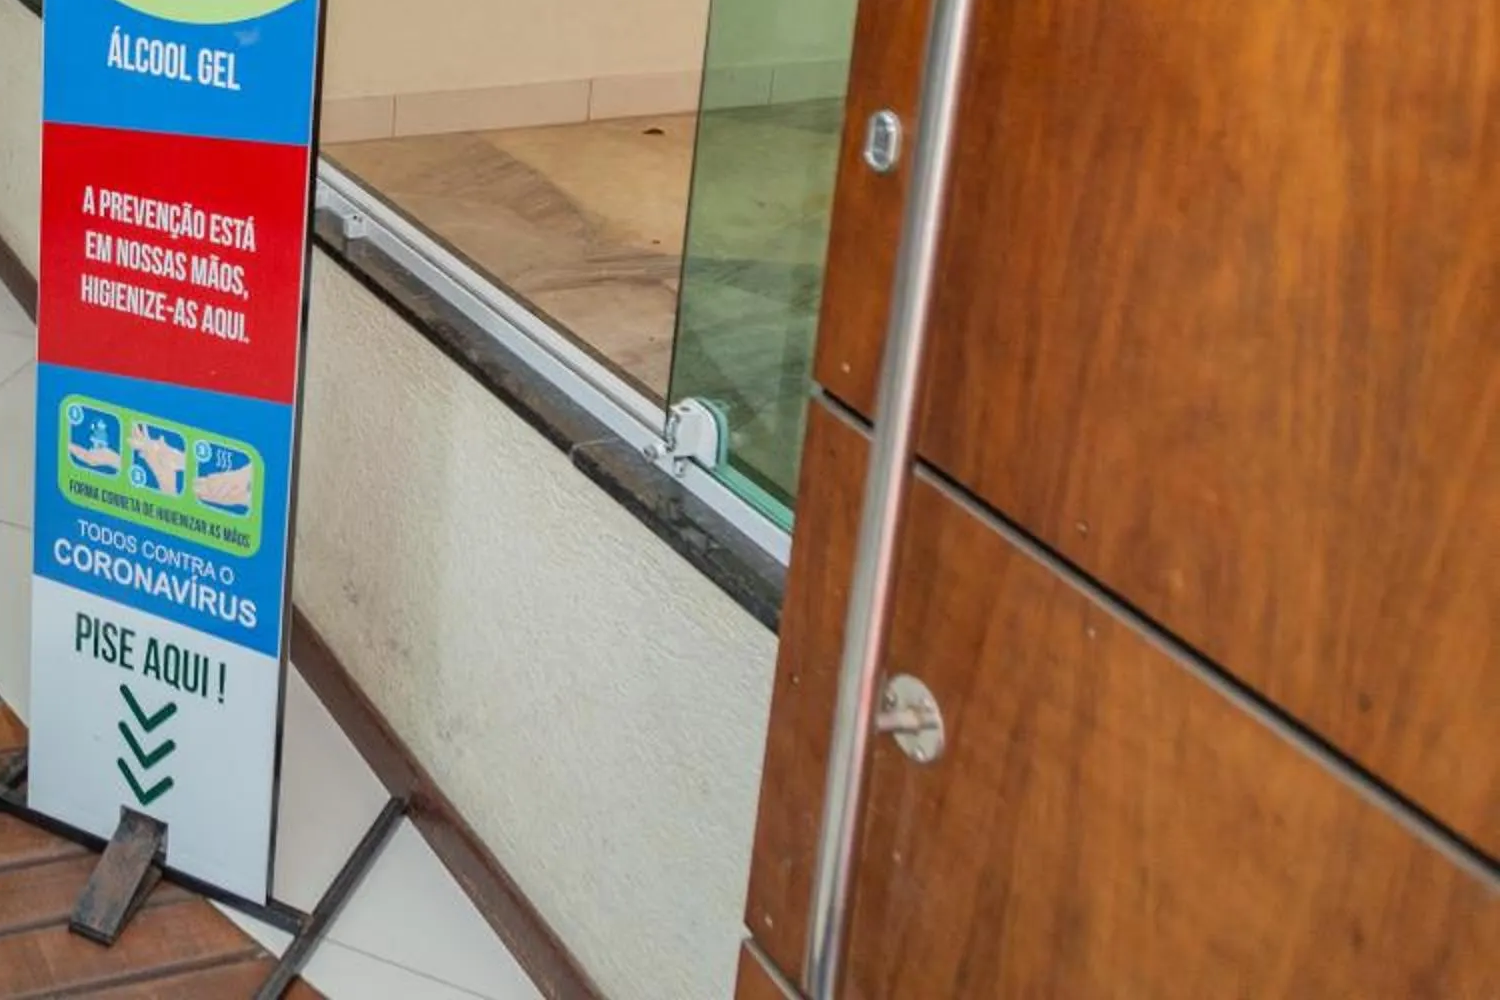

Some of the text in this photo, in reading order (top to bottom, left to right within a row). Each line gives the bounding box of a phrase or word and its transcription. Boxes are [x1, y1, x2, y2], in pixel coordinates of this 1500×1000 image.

[107, 25, 242, 92] ÁLCOOL GEL
[82, 185, 257, 253] A PREVENÇÃO ESTÁ
[85, 230, 250, 301] EM NOSSAS MÃOS,
[80, 273, 251, 344] HIGIENIZE-AS AQUI.
[69, 479, 100, 499] FORMA
[54, 537, 258, 628] CORONAVÍRUS
[77, 519, 235, 585] TODOS CONTRA O
[75, 612, 136, 671] PISE
[143, 636, 209, 698] AQUI
